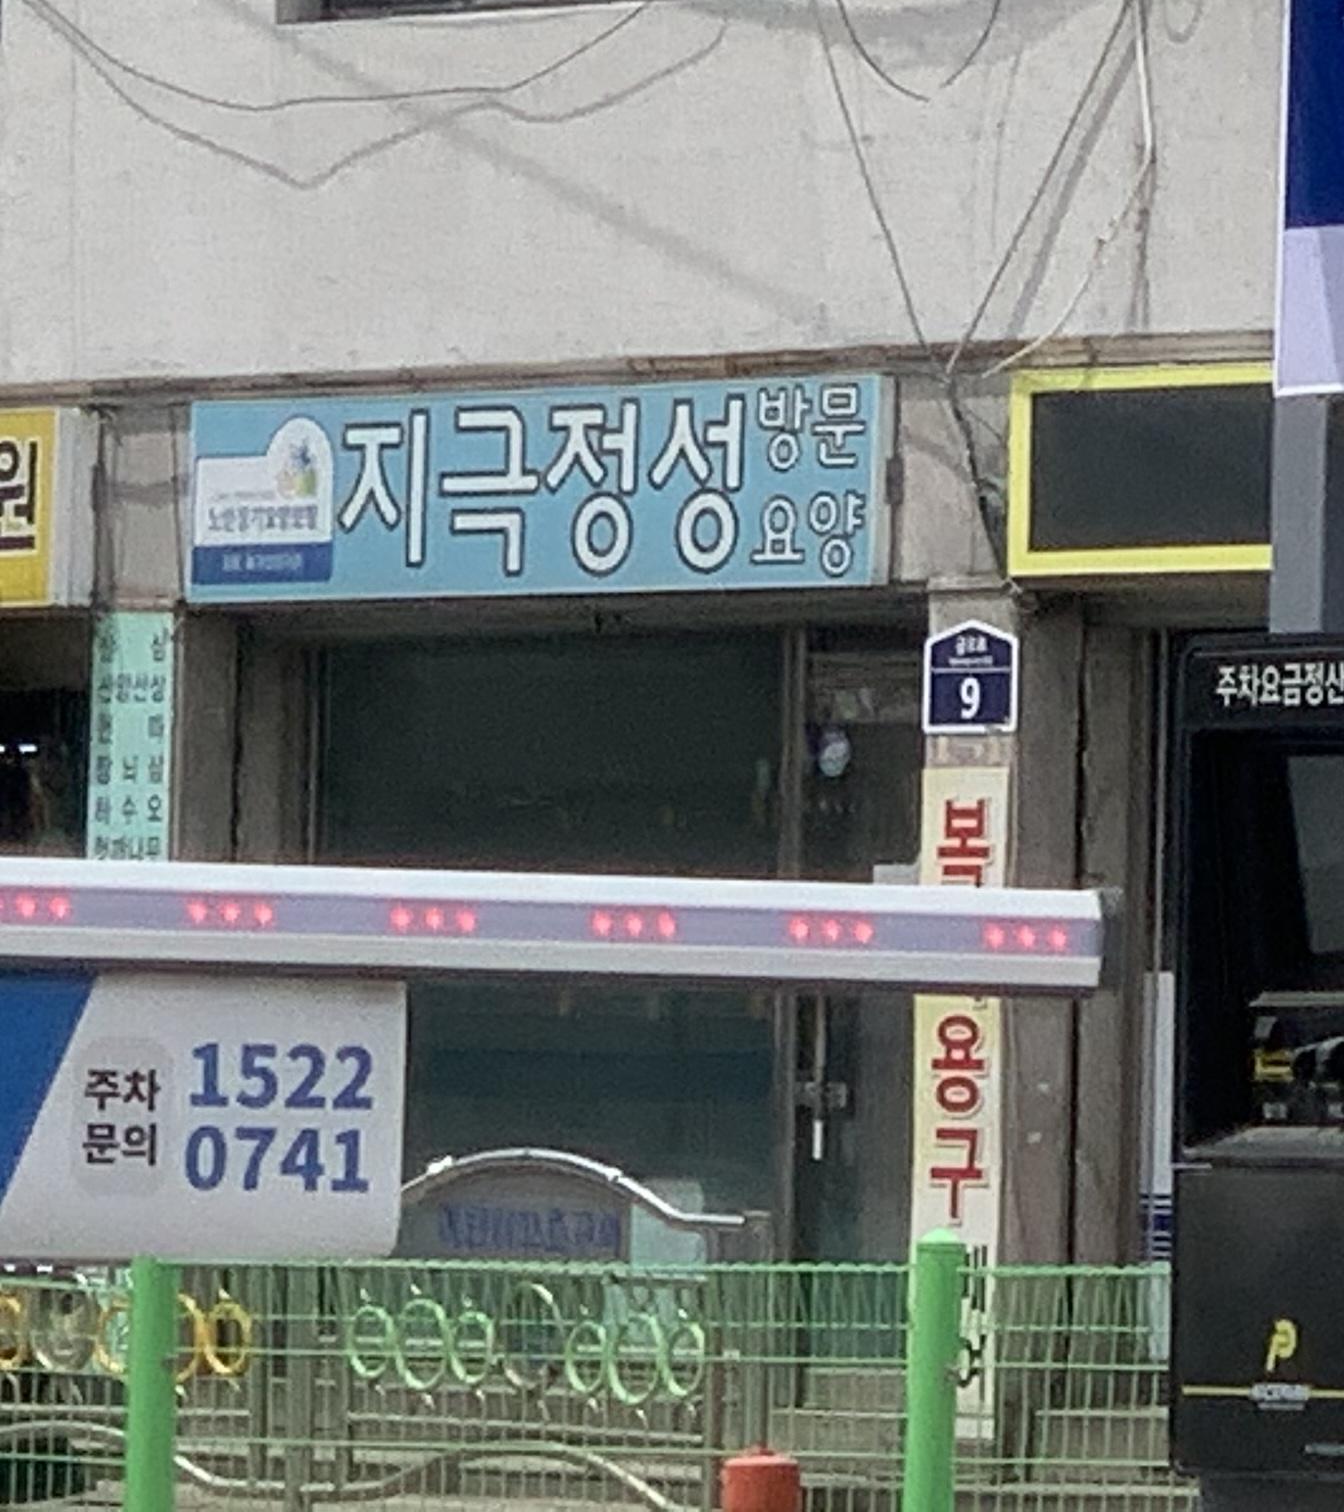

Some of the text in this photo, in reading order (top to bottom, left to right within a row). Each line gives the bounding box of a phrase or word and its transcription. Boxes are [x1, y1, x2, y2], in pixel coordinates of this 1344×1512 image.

[756, 382, 867, 472] 방문
[336, 394, 747, 578] 지극정성
[748, 488, 866, 577] 요양
[960, 676, 981, 720] 9
[83, 1068, 162, 1112] 주차
[189, 1042, 373, 1110] 1522
[81, 1122, 158, 1167] 문의
[184, 1124, 370, 1194] 0741
